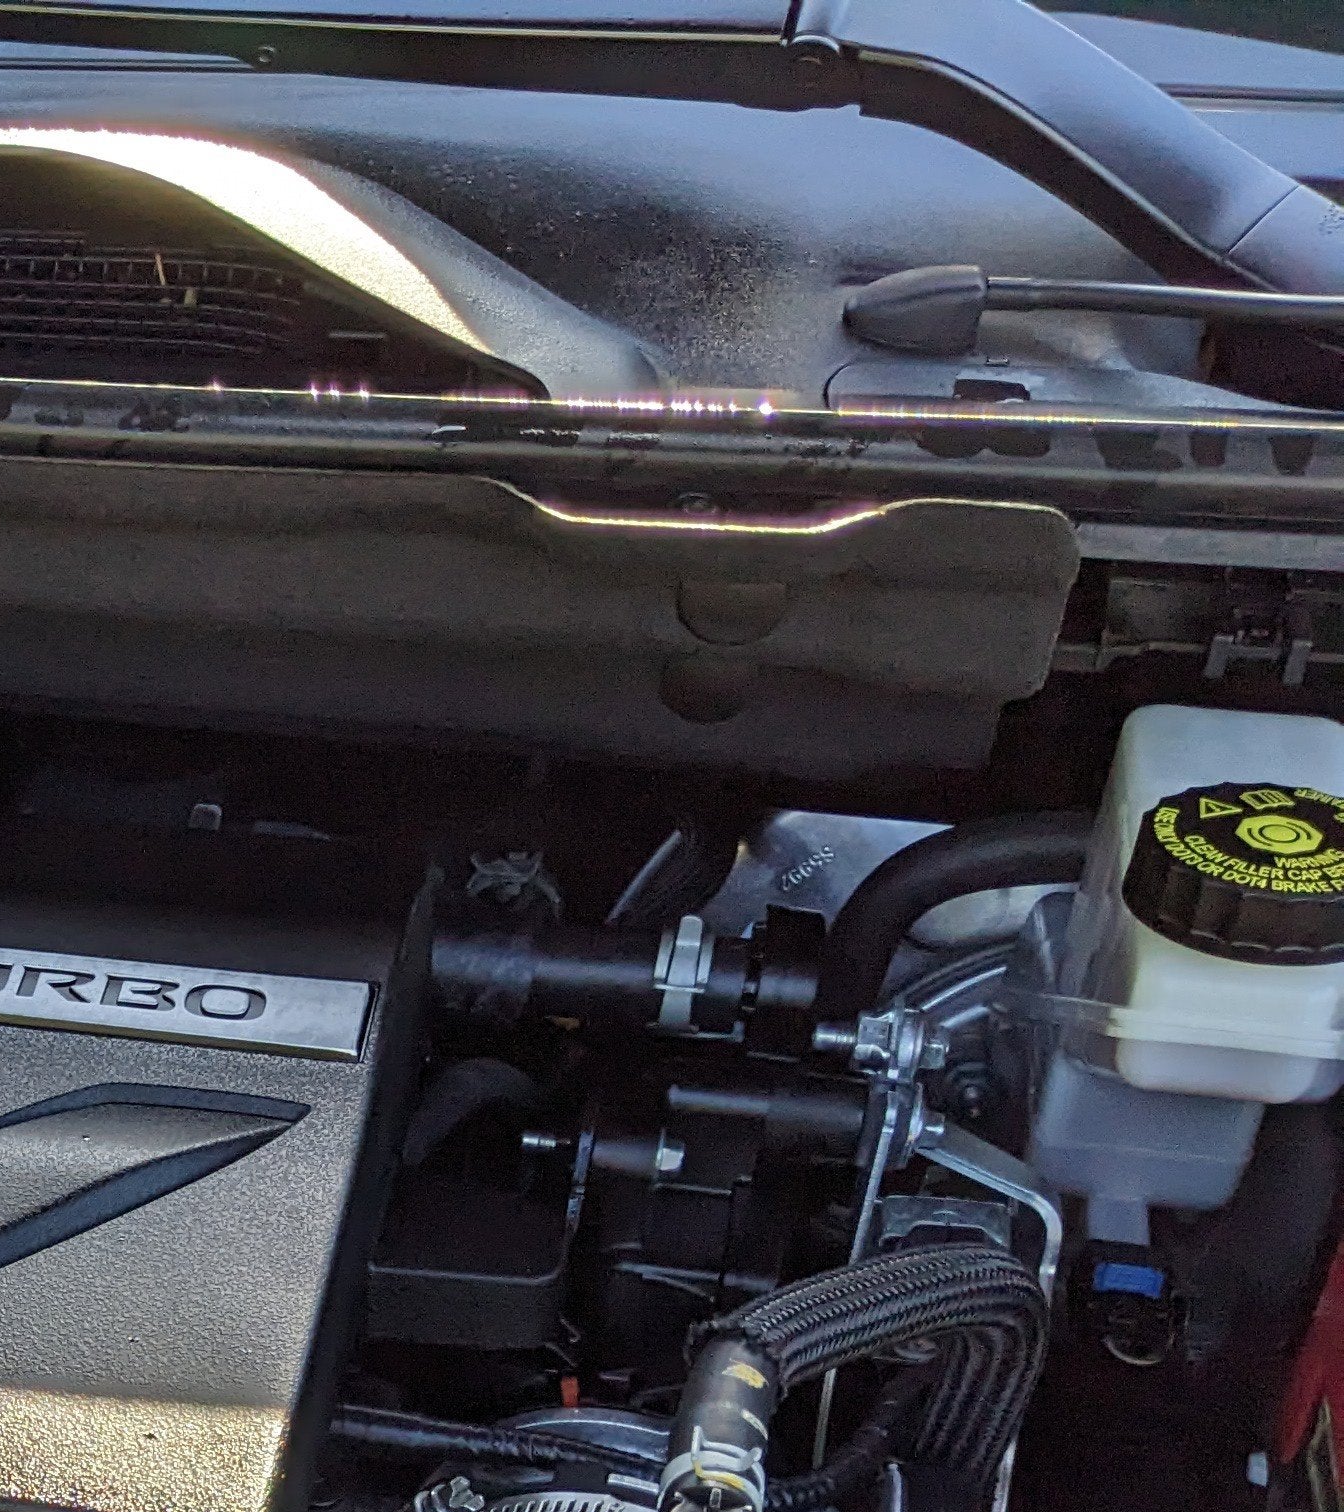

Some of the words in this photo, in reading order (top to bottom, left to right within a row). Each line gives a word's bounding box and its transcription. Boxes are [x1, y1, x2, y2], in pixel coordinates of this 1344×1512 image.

[1184, 835, 1230, 863] CLEAN
[1223, 858, 1284, 879] FILLER
[1287, 868, 1322, 880] CAP
[1197, 862, 1224, 876] OR
[1222, 870, 1268, 889] DOT4
[1272, 880, 1333, 892] BRAKE
